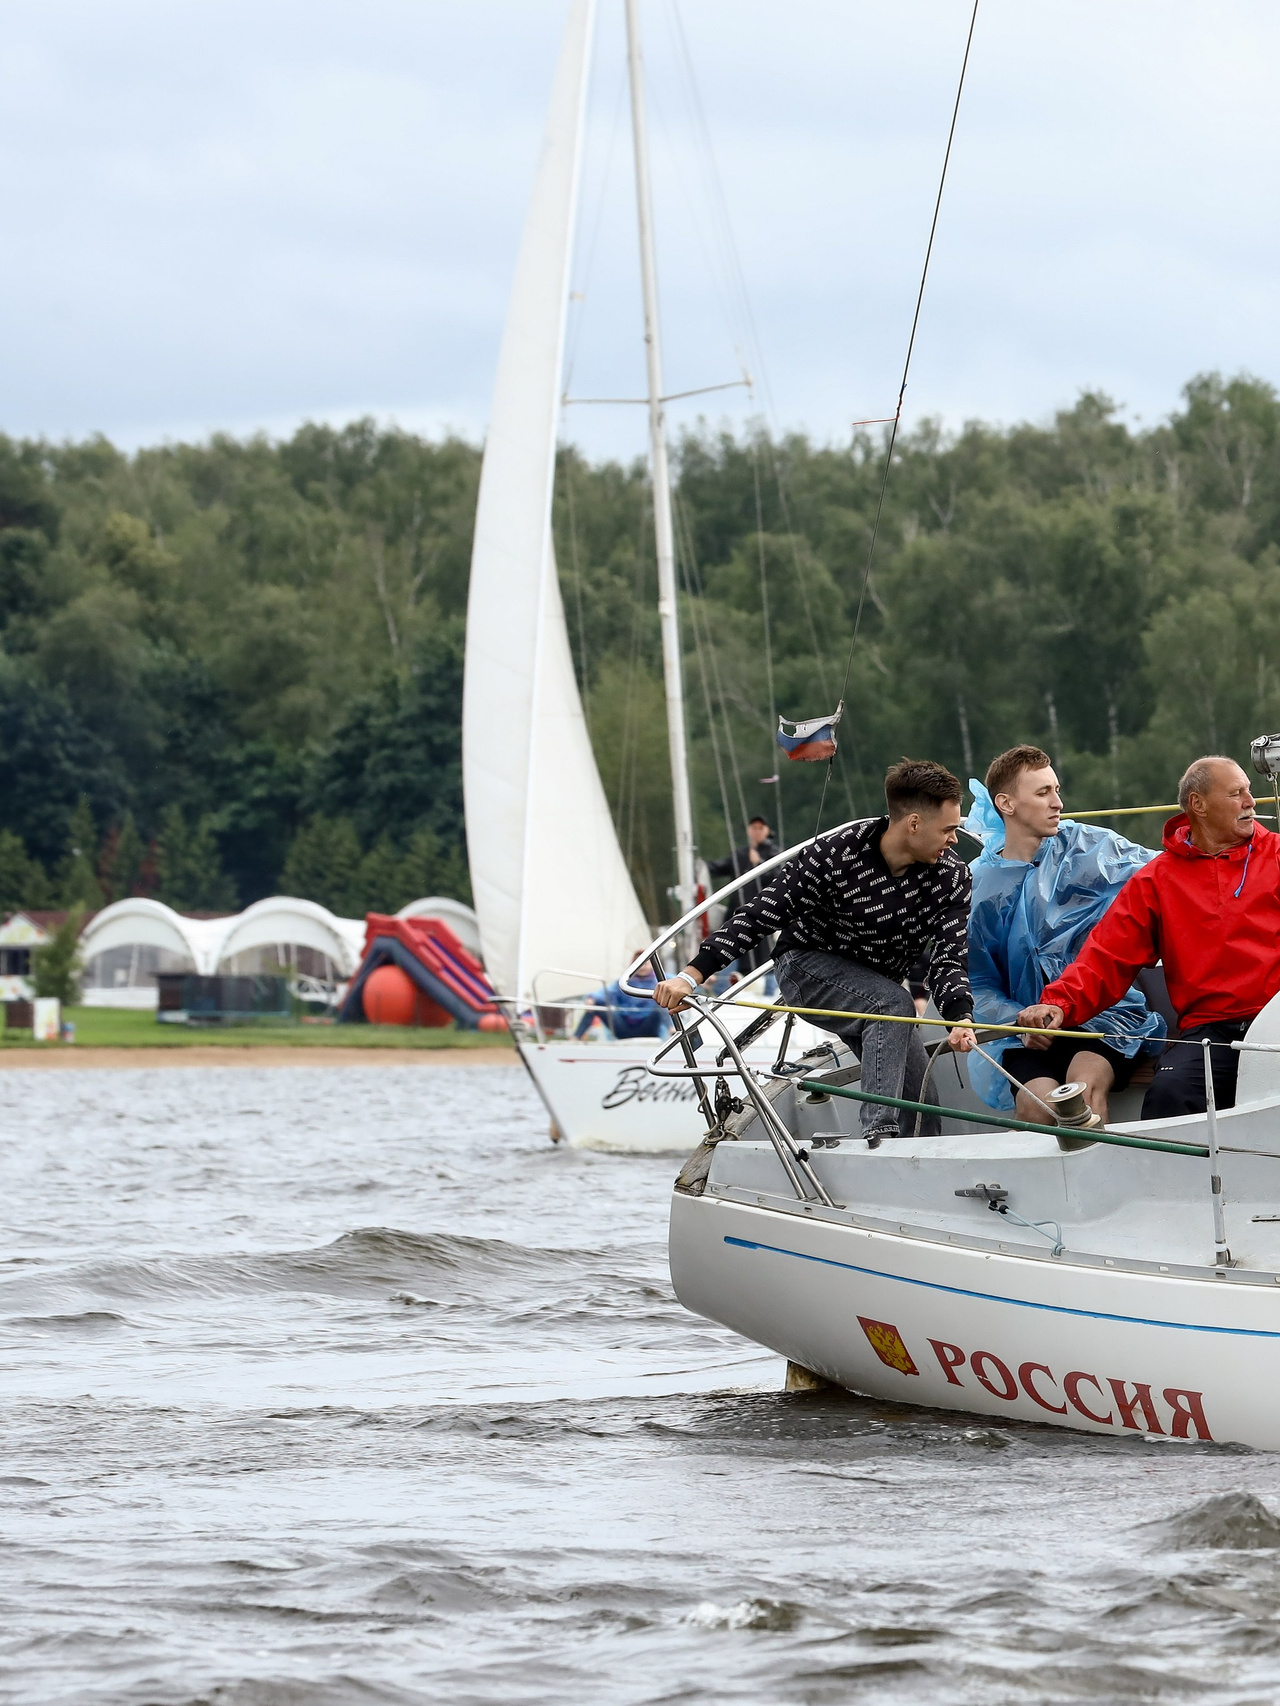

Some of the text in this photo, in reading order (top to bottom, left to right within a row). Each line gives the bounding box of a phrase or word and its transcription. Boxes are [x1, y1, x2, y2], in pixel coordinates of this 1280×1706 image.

[870, 876, 887, 886] MISTAKE
[844, 887, 860, 898] MISTAKE
[865, 904, 884, 913] MISTAKE
[761, 910, 780, 920] MISTAKE
[715, 937, 734, 947] MISTAKE
[926, 1338, 1214, 1442] РОССИЯ
